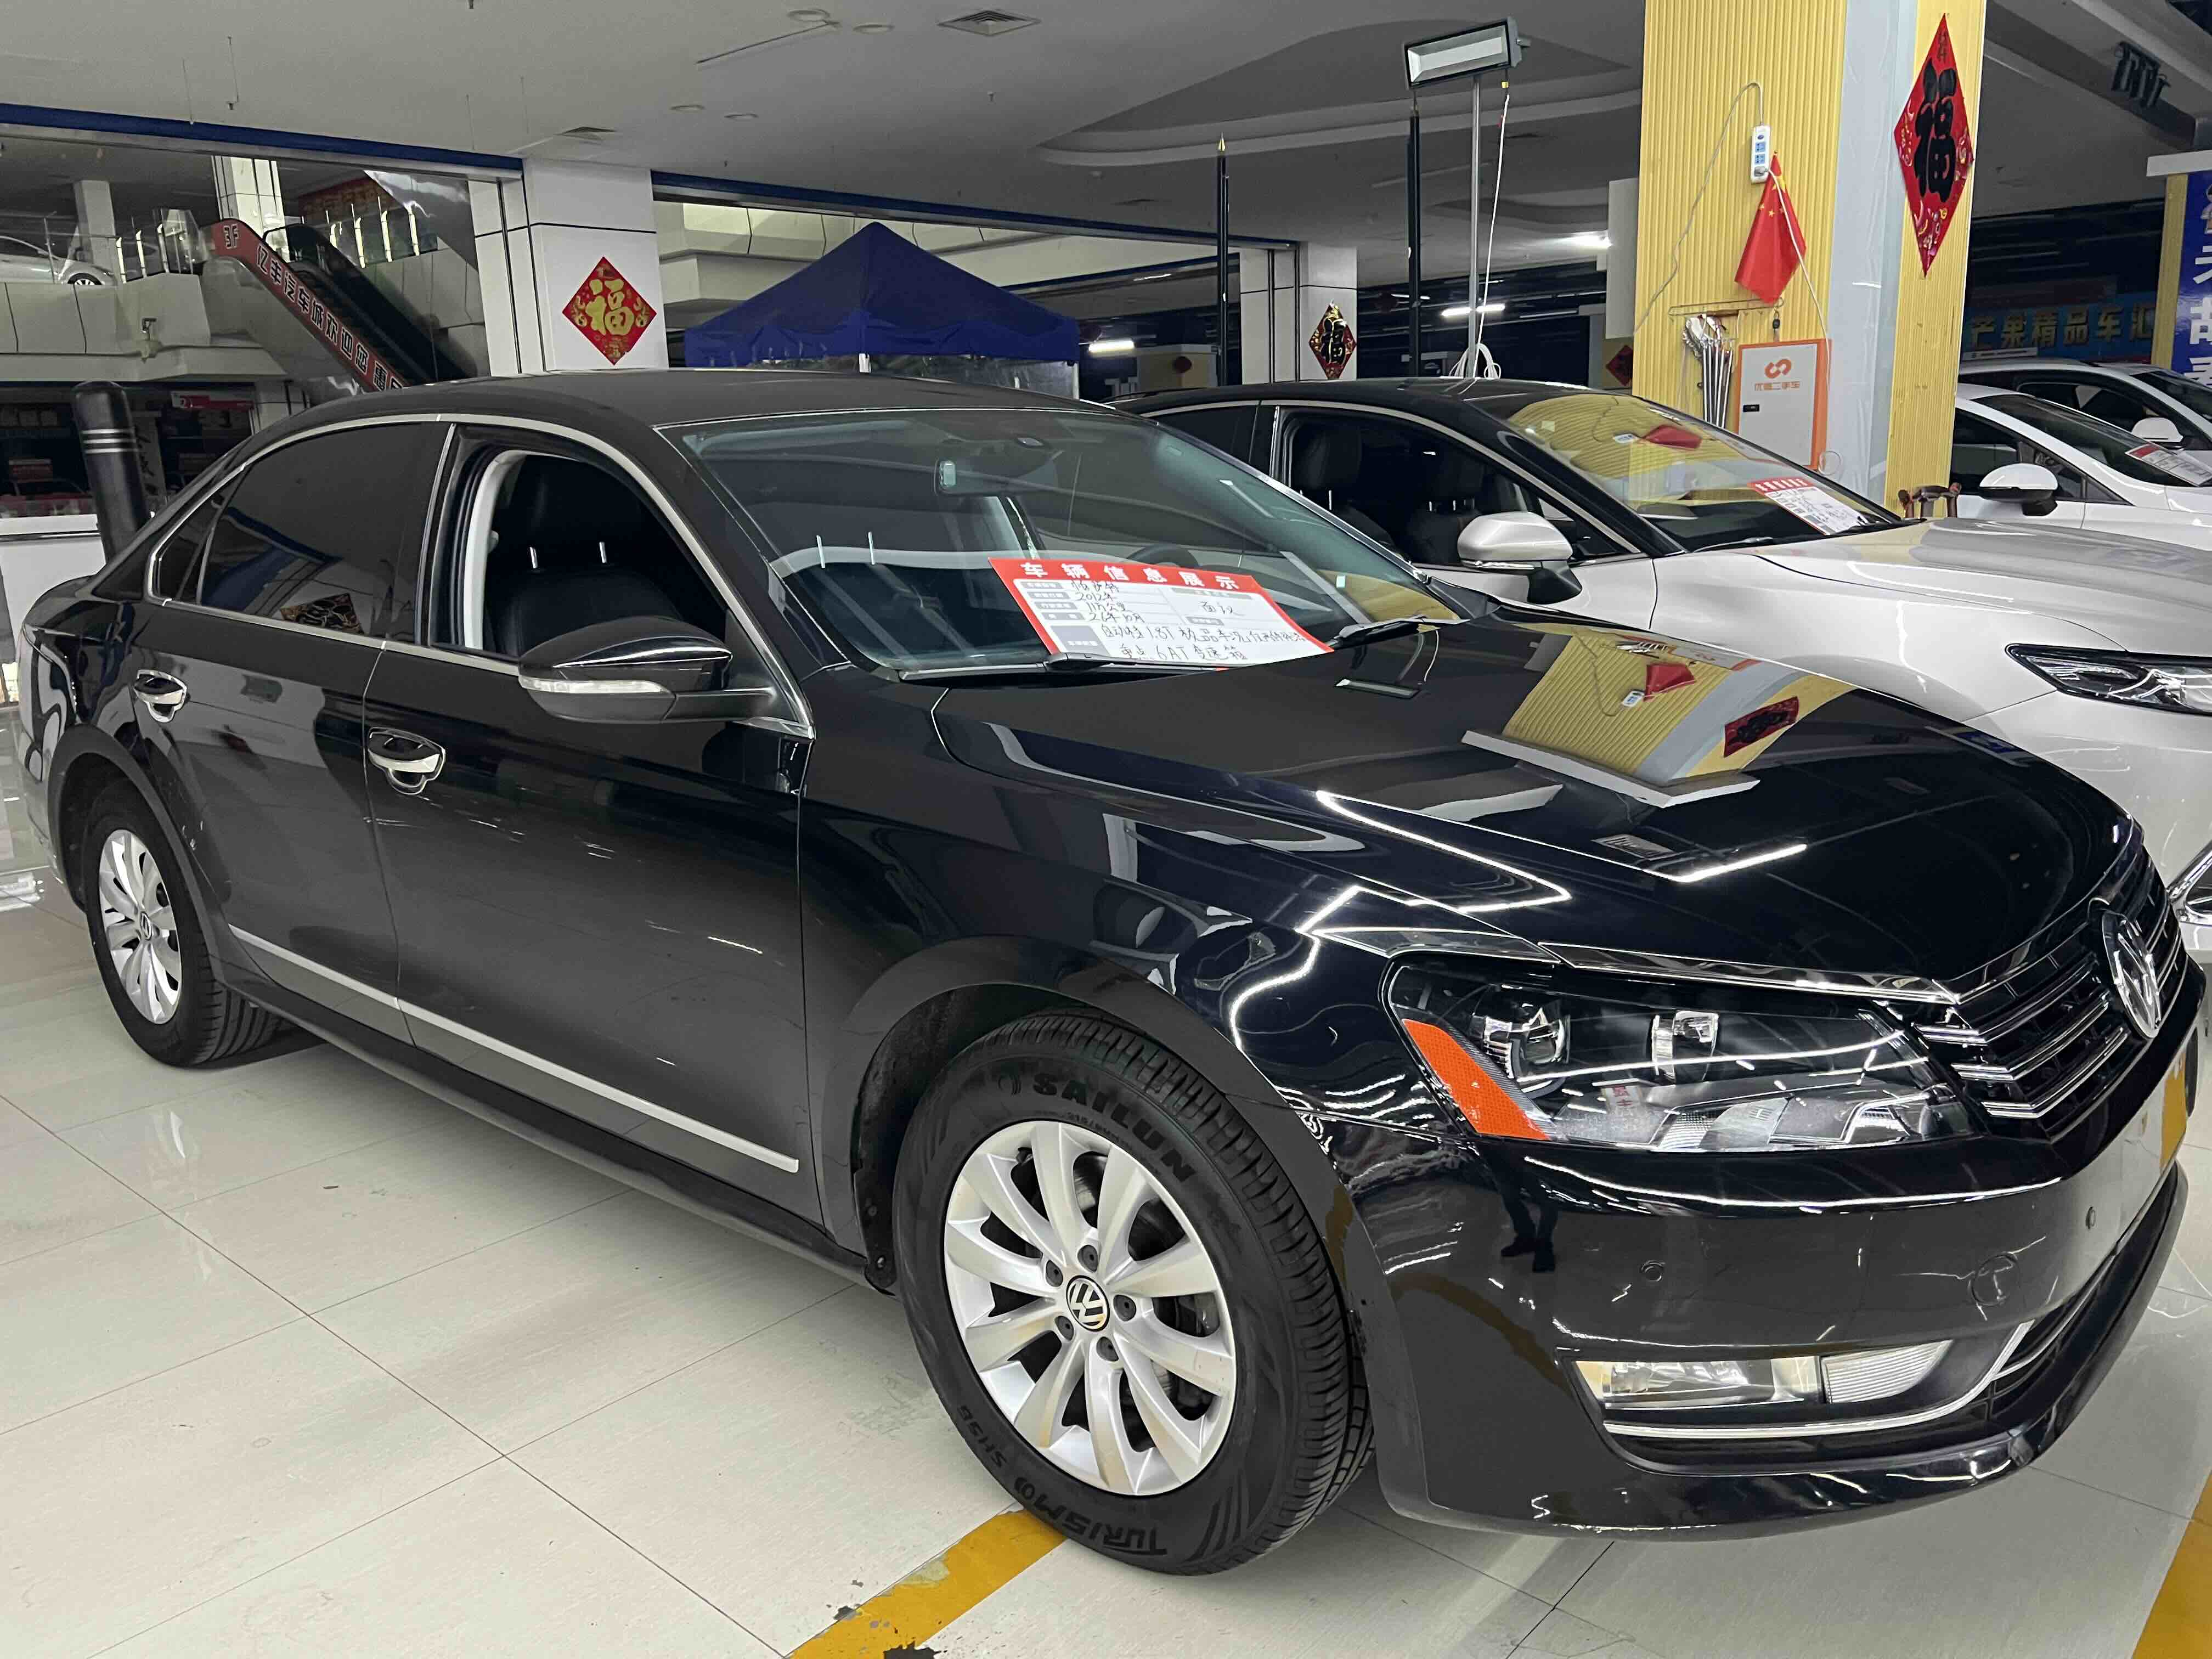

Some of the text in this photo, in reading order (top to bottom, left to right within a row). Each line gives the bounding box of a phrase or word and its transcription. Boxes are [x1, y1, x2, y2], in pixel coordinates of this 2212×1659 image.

[223, 224, 240, 249] 3F
[585, 278, 635, 336] 福
[1020, 561, 1239, 590] 车辆信息展示
[1075, 592, 1118, 602] 2012年
[1155, 645, 1190, 660] 6AT
[1032, 1073, 1197, 1182] SAILUN
[1014, 1476, 1168, 1556] TURISMO
